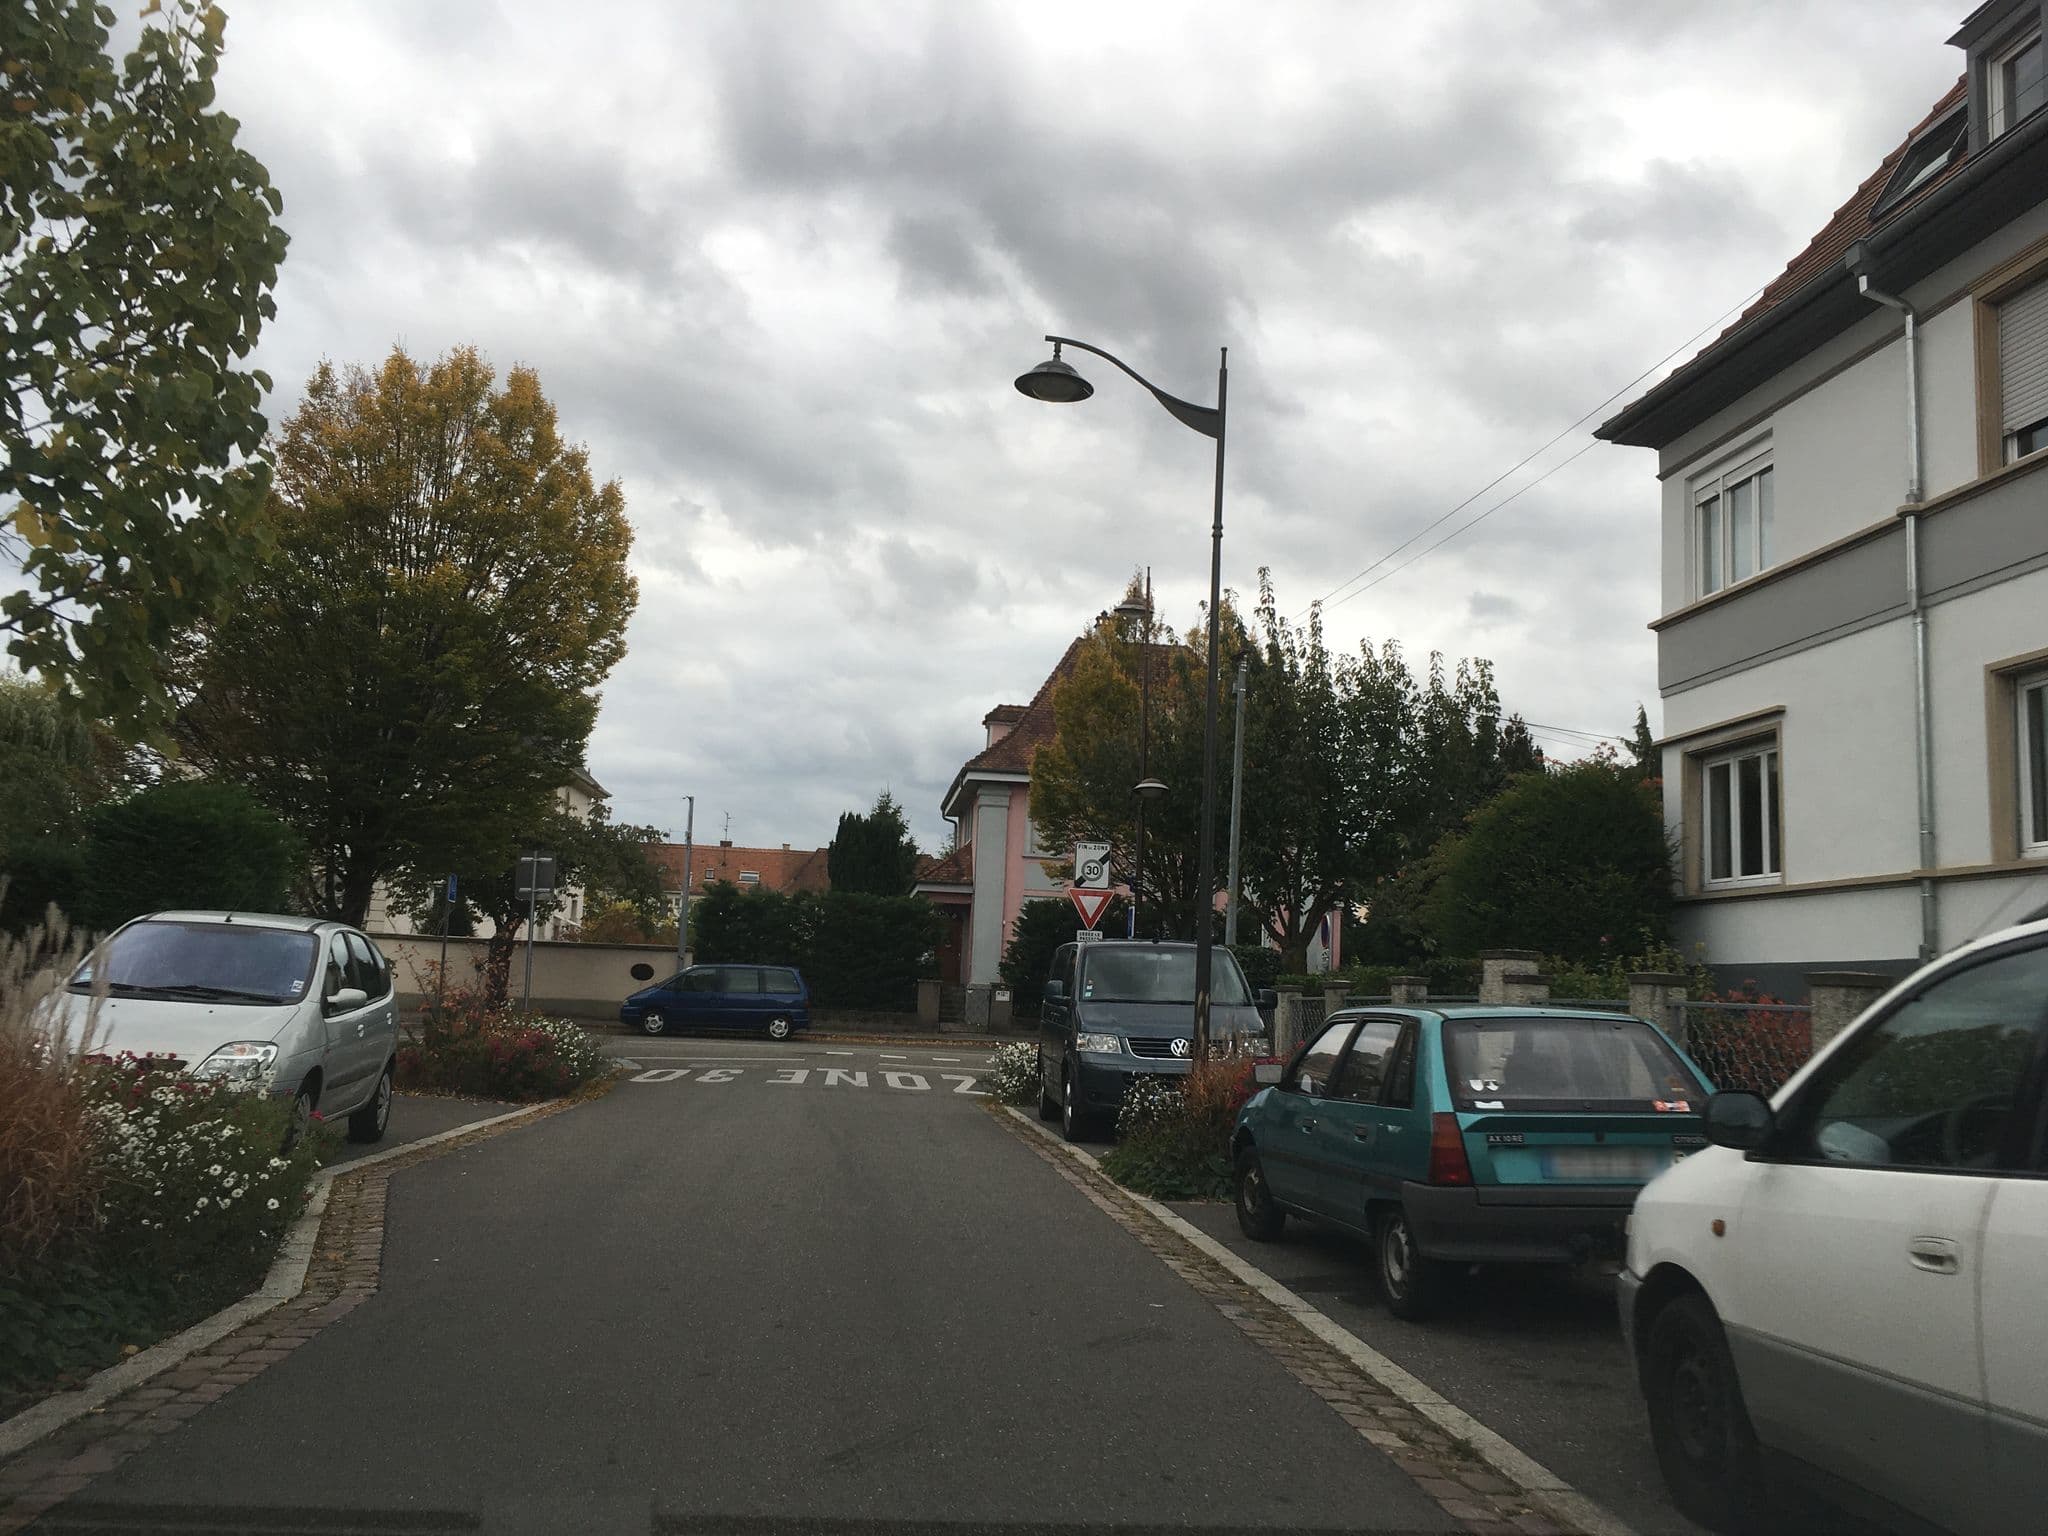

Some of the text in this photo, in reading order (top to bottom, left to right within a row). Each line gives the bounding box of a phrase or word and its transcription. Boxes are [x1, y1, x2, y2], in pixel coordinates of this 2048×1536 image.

[1086, 865, 1100, 876] 30
[629, 1067, 993, 1096] ZONE 30
